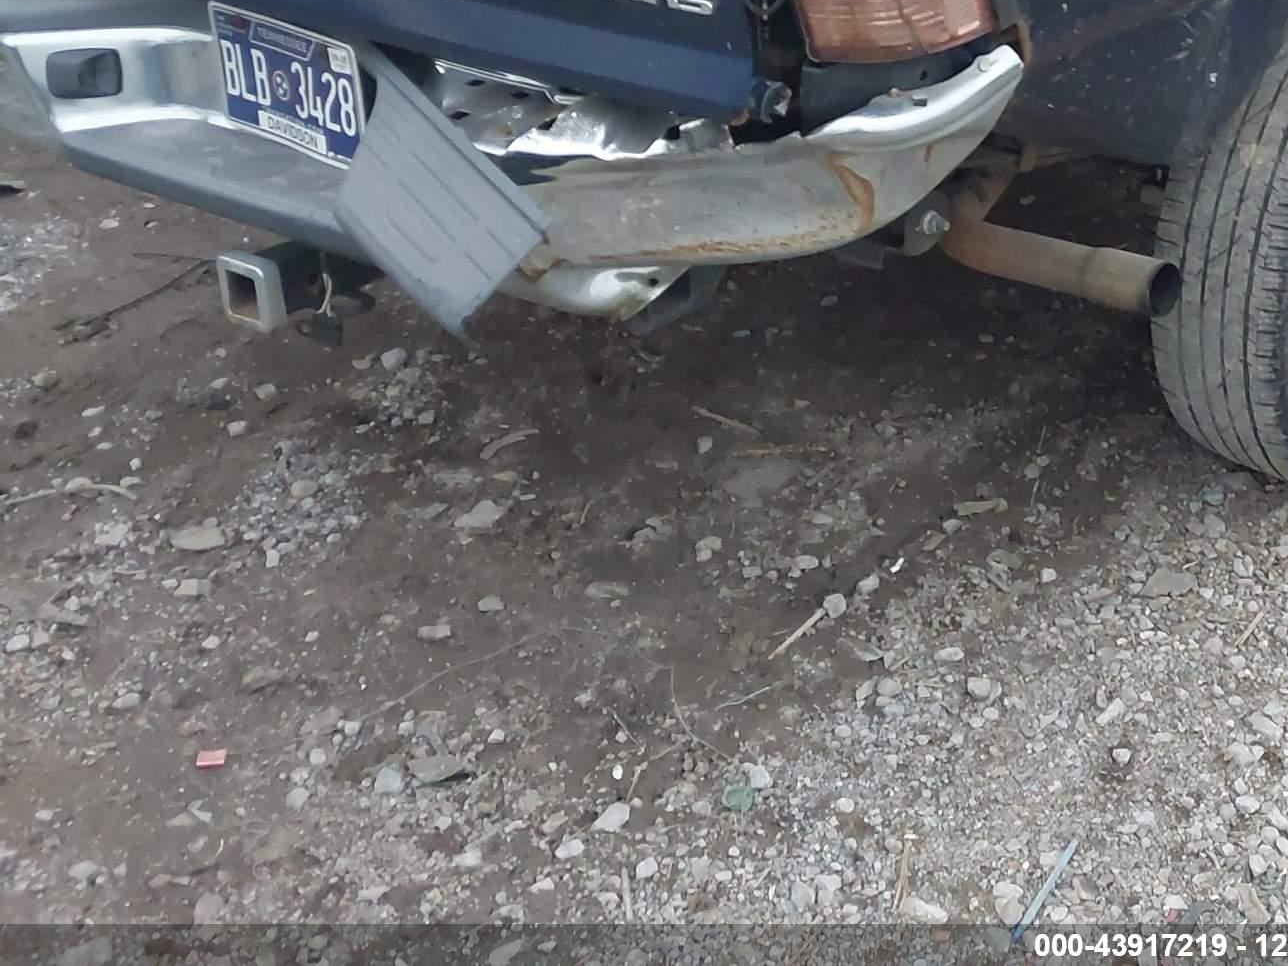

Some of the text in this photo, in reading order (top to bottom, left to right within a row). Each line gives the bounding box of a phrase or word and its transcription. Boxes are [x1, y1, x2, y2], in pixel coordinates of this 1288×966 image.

[219, 38, 357, 137] BLB 3428
[266, 115, 319, 149] DAVIDSON
